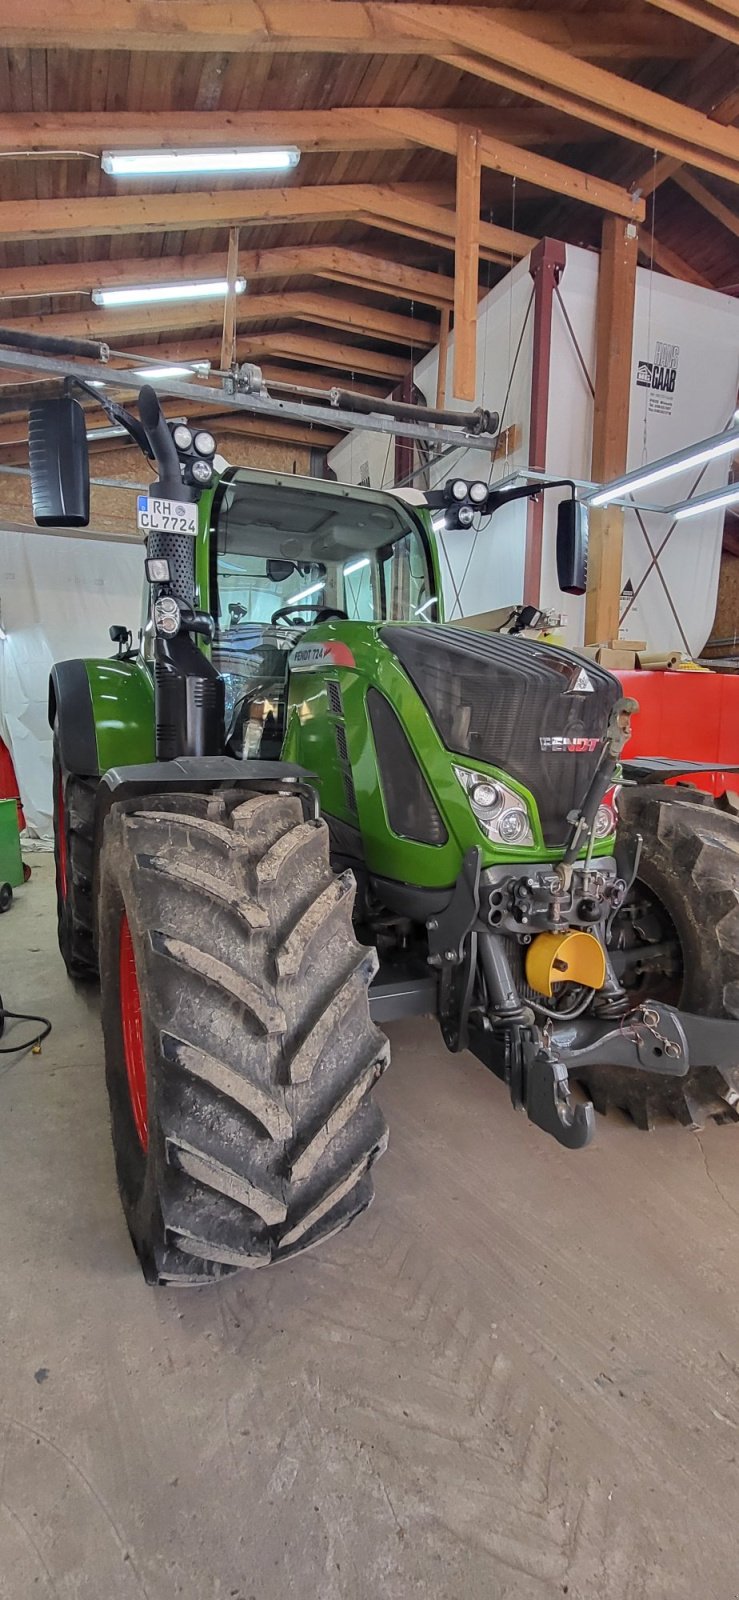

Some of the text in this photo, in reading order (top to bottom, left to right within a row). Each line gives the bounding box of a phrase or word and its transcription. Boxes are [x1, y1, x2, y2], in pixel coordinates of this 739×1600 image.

[651, 365, 677, 393] GAAB
[153, 501, 171, 515] RH
[141, 513, 196, 533] CL 7724
[294, 649, 312, 661] FENDT
[312, 648, 324, 660] 724
[539, 736, 600, 752] FENDT
